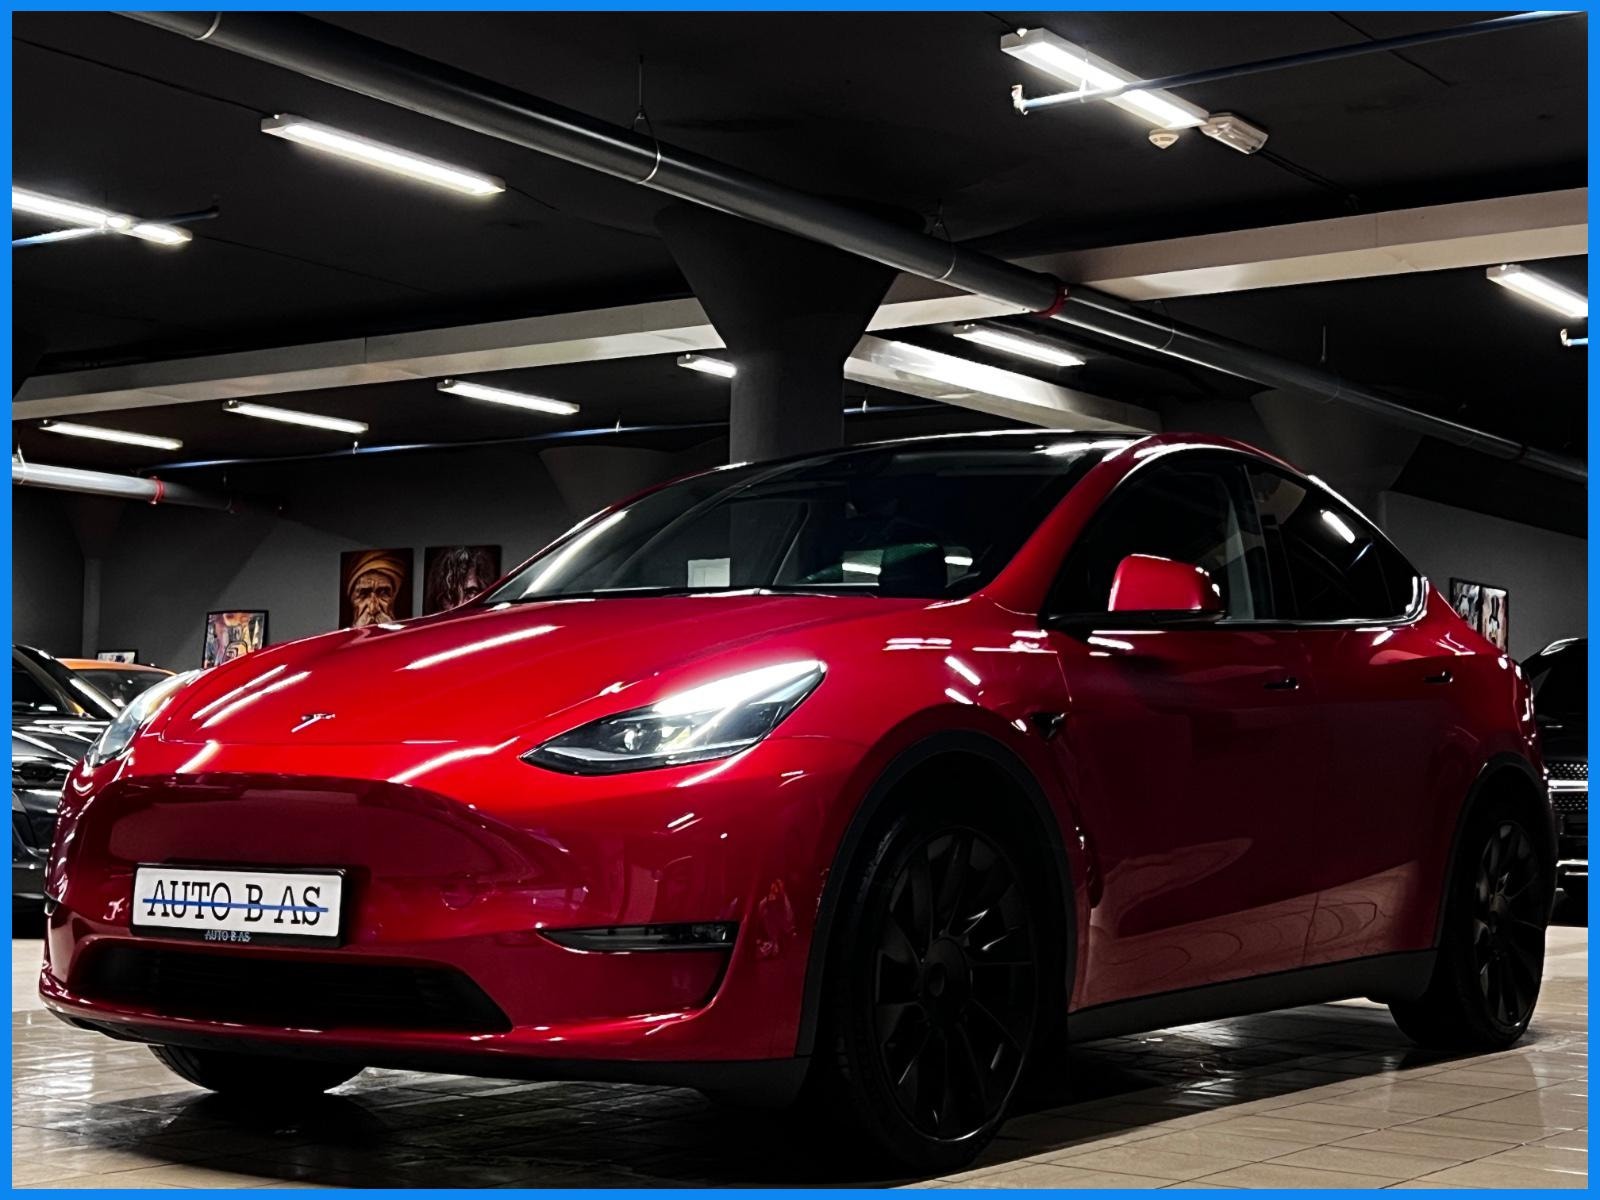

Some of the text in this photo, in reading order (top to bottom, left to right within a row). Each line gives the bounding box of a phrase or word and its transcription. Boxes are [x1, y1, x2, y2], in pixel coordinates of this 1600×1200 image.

[147, 879, 321, 926] AUTO B AS
[204, 929, 229, 941] AUTO
